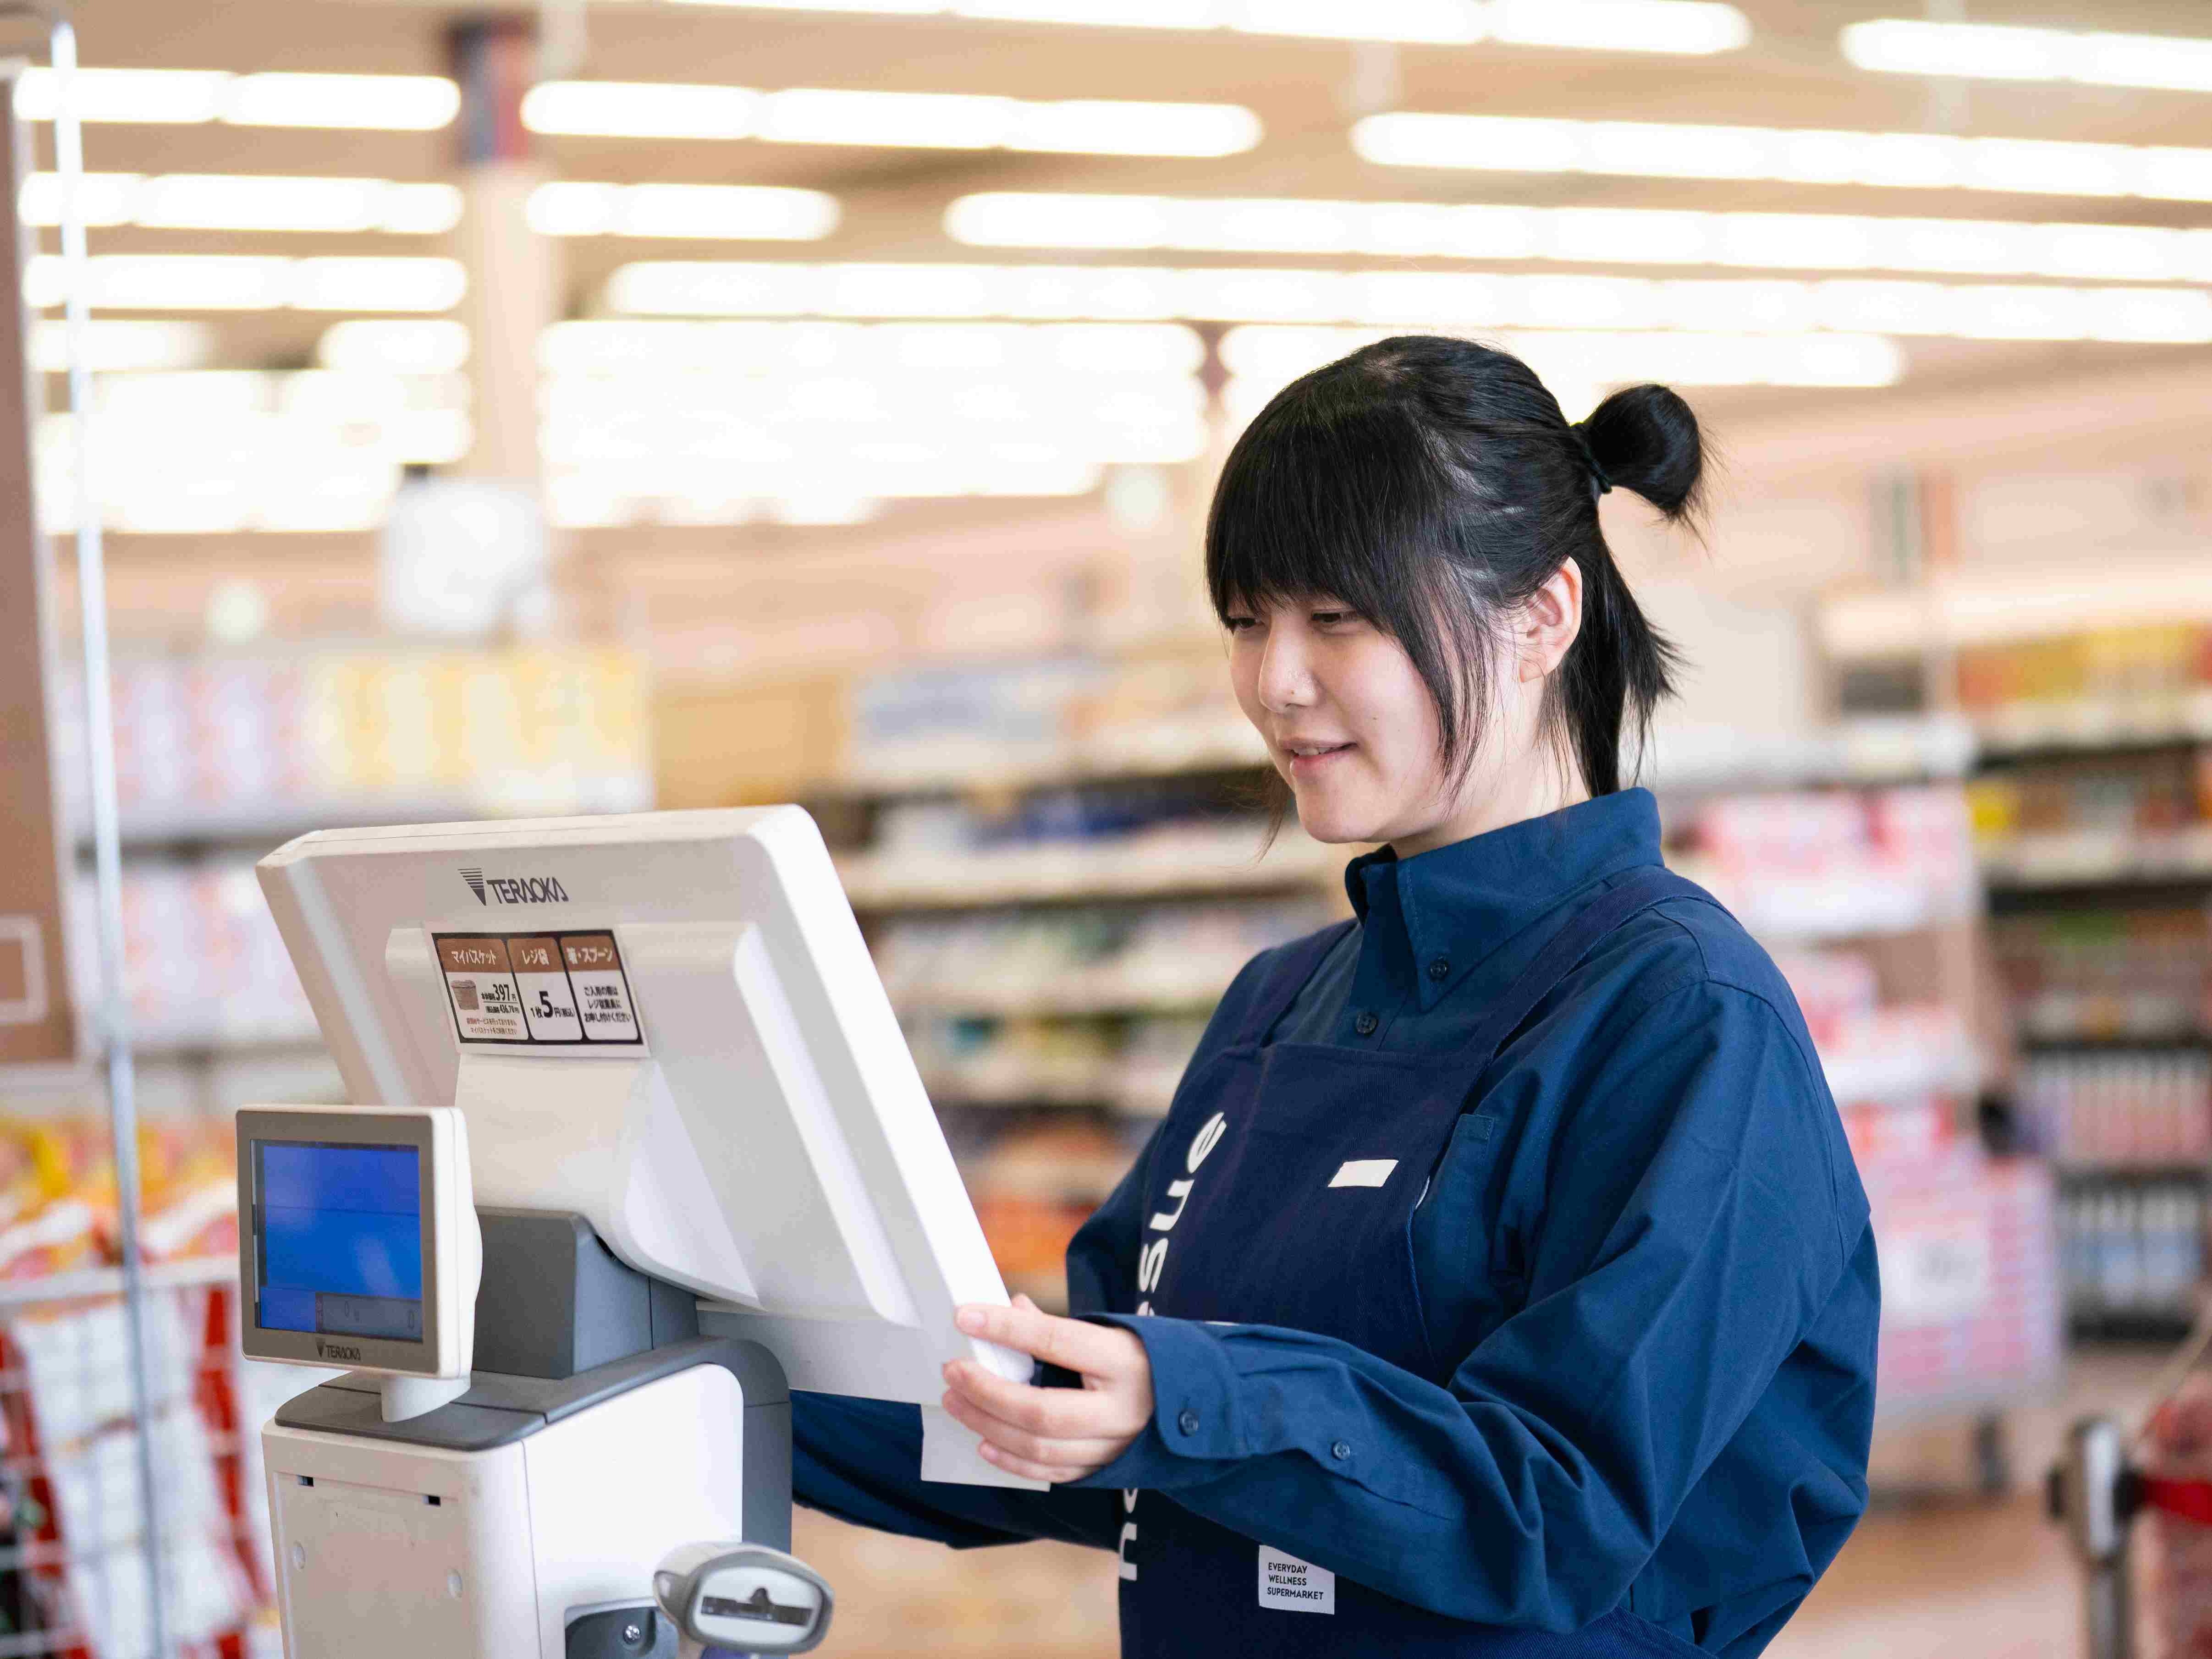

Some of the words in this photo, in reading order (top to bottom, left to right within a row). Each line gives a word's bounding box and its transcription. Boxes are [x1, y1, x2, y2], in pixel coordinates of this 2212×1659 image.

[451, 949, 497, 965] マイバスケット
[1268, 1562, 1307, 1574] EVERYDAY
[1269, 1574, 1307, 1586] WELLNESS
[1267, 1587, 1324, 1600] SUPERMARKET
